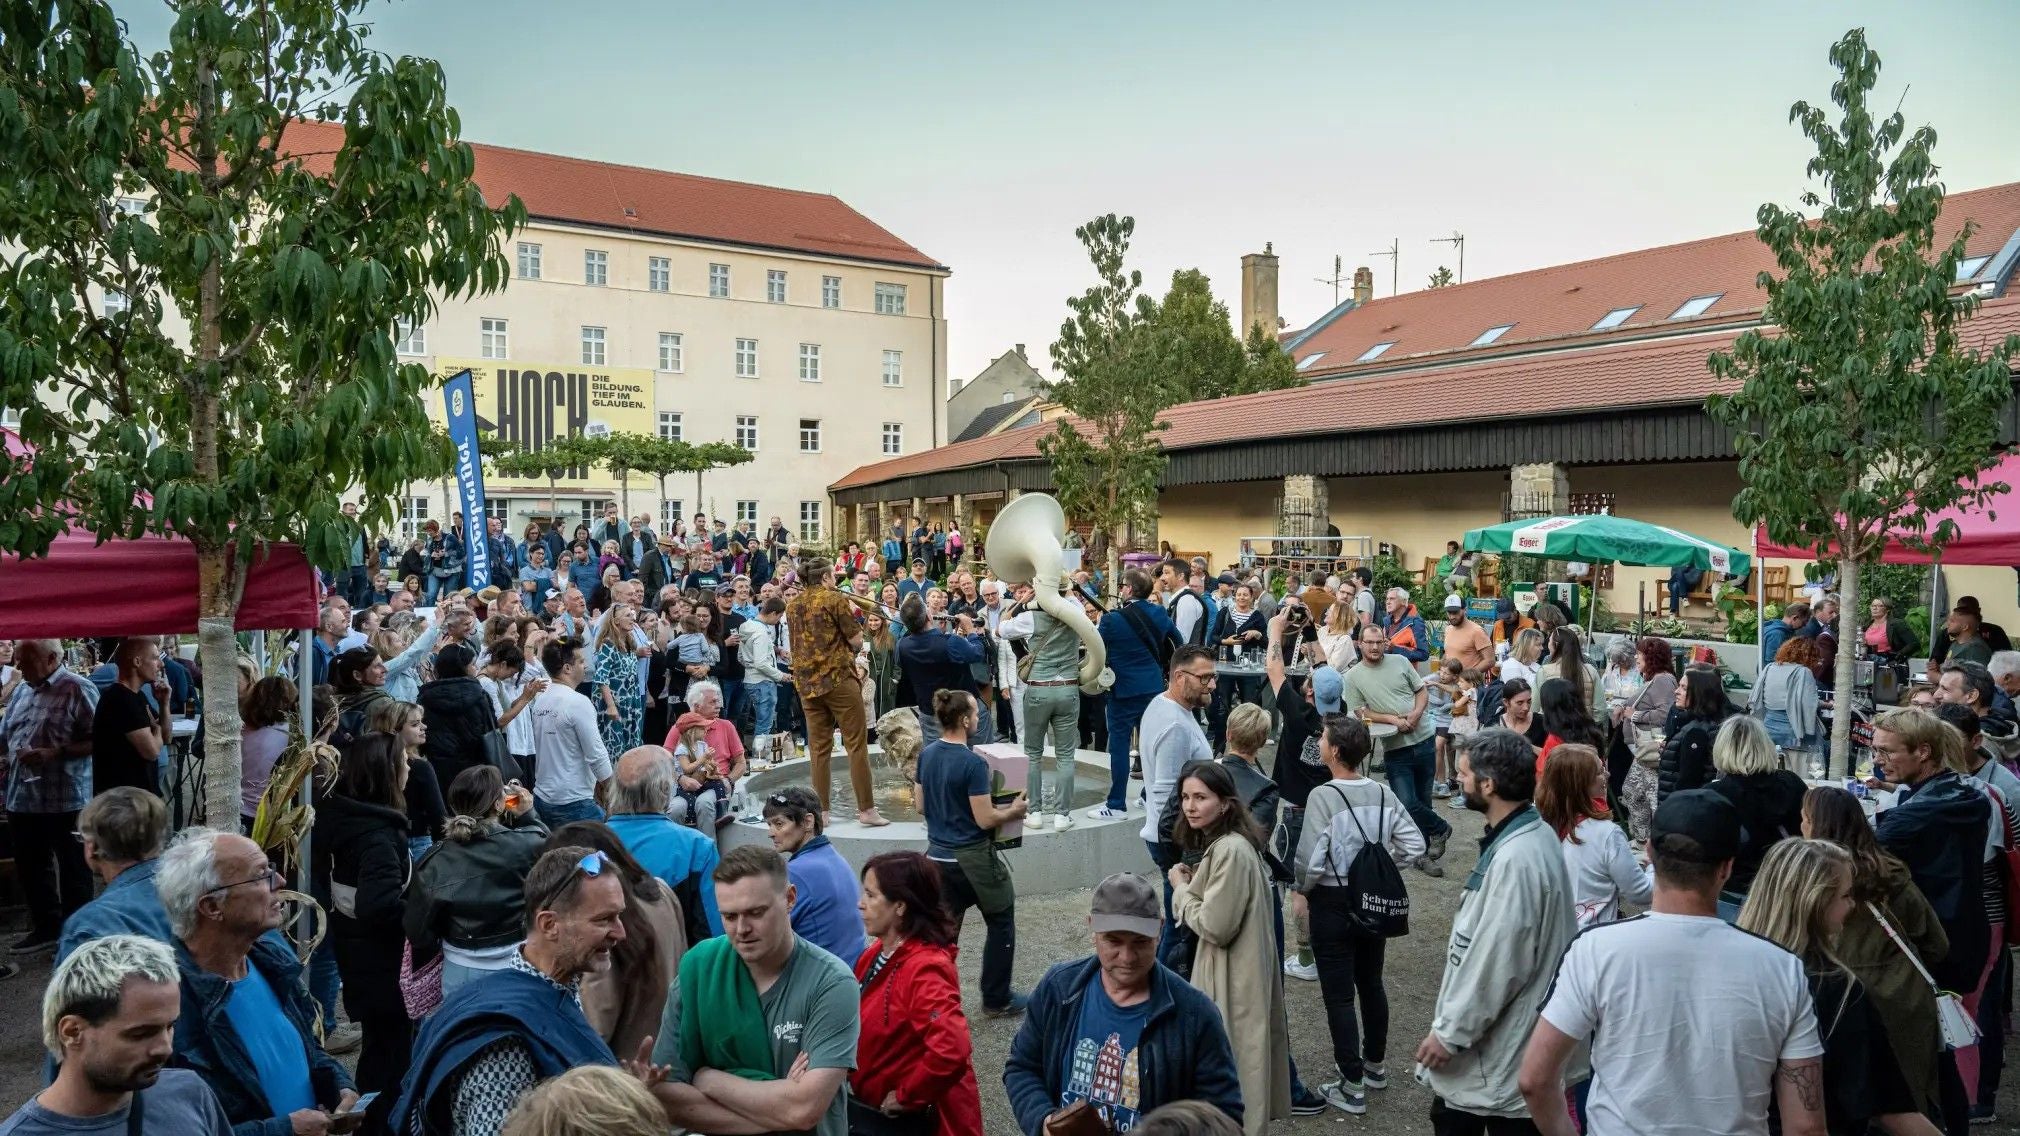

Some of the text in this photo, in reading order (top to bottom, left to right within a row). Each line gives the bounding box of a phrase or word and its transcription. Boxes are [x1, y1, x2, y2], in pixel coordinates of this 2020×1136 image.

[592, 383, 643, 392] BILDUNG.
[592, 391, 615, 399] TIEF
[592, 399, 646, 409] GLAUBEN.
[497, 369, 588, 479] HOCH
[1518, 537, 1539, 548] Egger
[1362, 892, 1401, 907] Schwarz
[1362, 901, 1386, 913] Bunt
